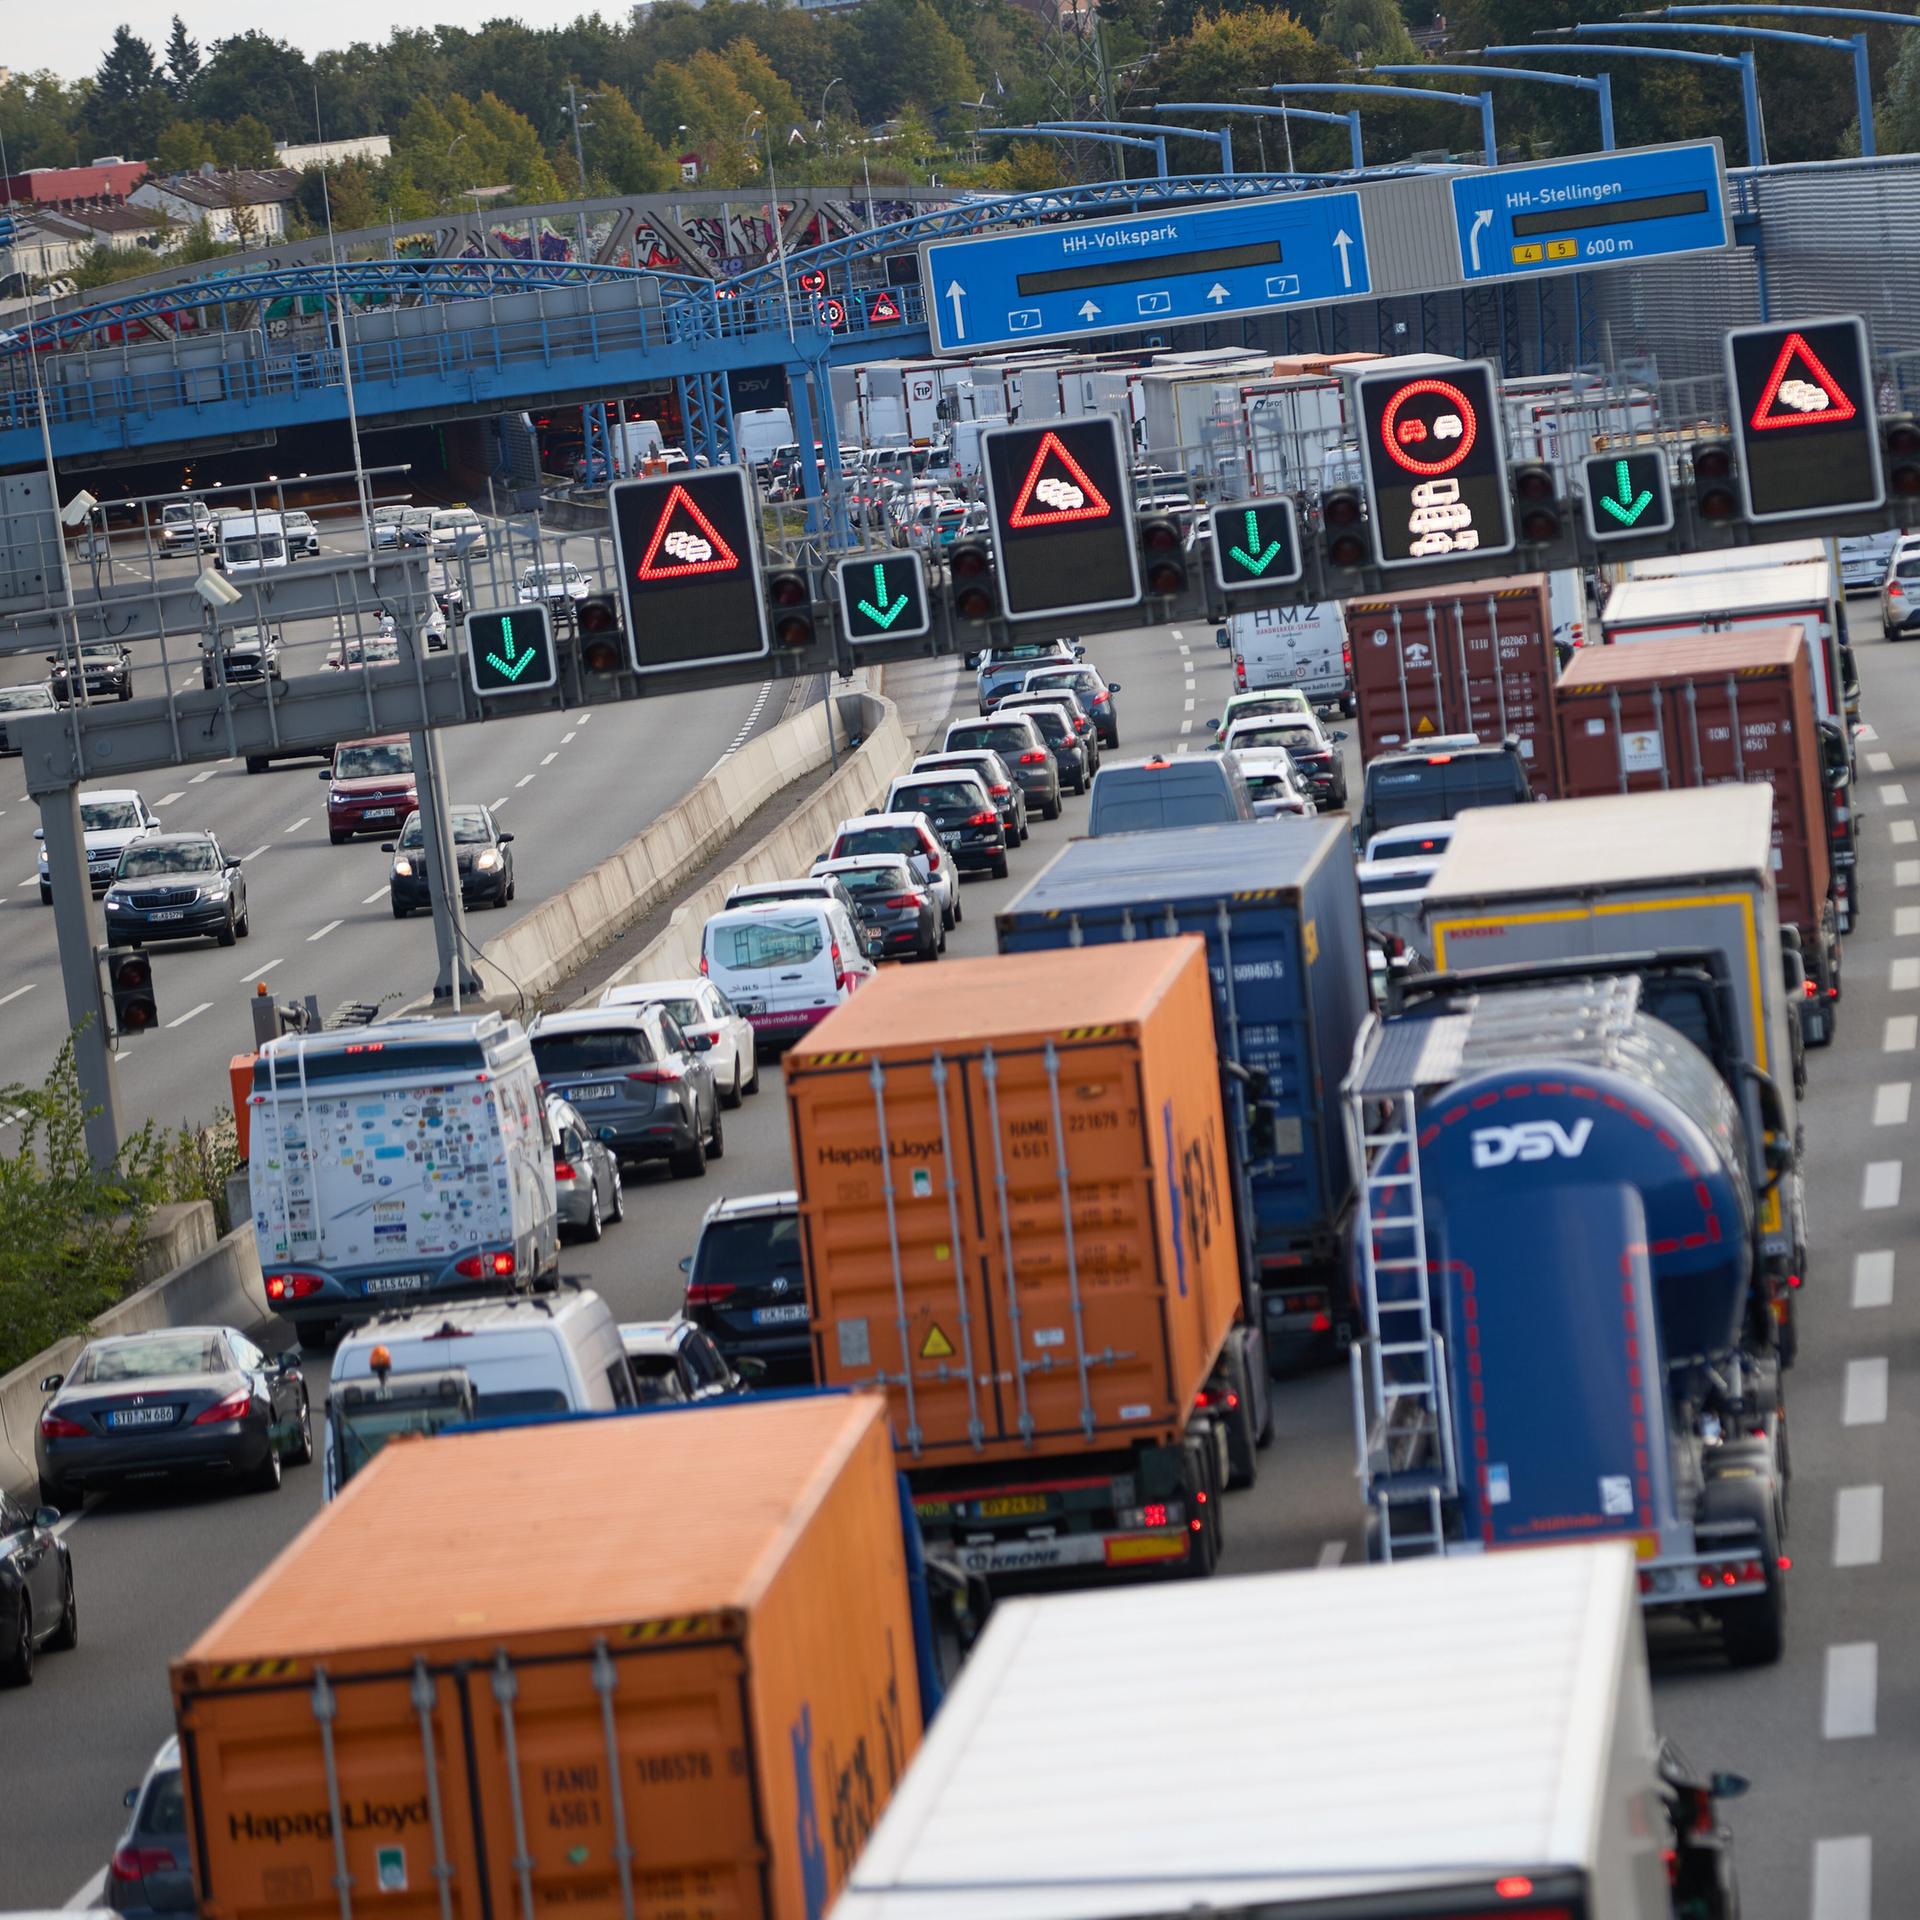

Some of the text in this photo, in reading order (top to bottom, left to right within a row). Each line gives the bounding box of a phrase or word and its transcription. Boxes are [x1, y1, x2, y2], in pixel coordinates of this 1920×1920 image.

[1506, 182, 1622, 208] HH-Stellingen
[1062, 224, 1178, 253] HH-Volkspark
[1586, 238, 1615, 256] 600
[1618, 239, 1633, 251] m
[738, 379, 770, 392] DSV
[916, 387, 930, 397] TIP
[1255, 604, 1320, 628] HMZ
[1010, 1117, 1048, 1137] HAMU
[1471, 1117, 1594, 1168] DSV
[989, 1548, 1060, 1570] KRONE
[543, 1764, 598, 1793] FANU
